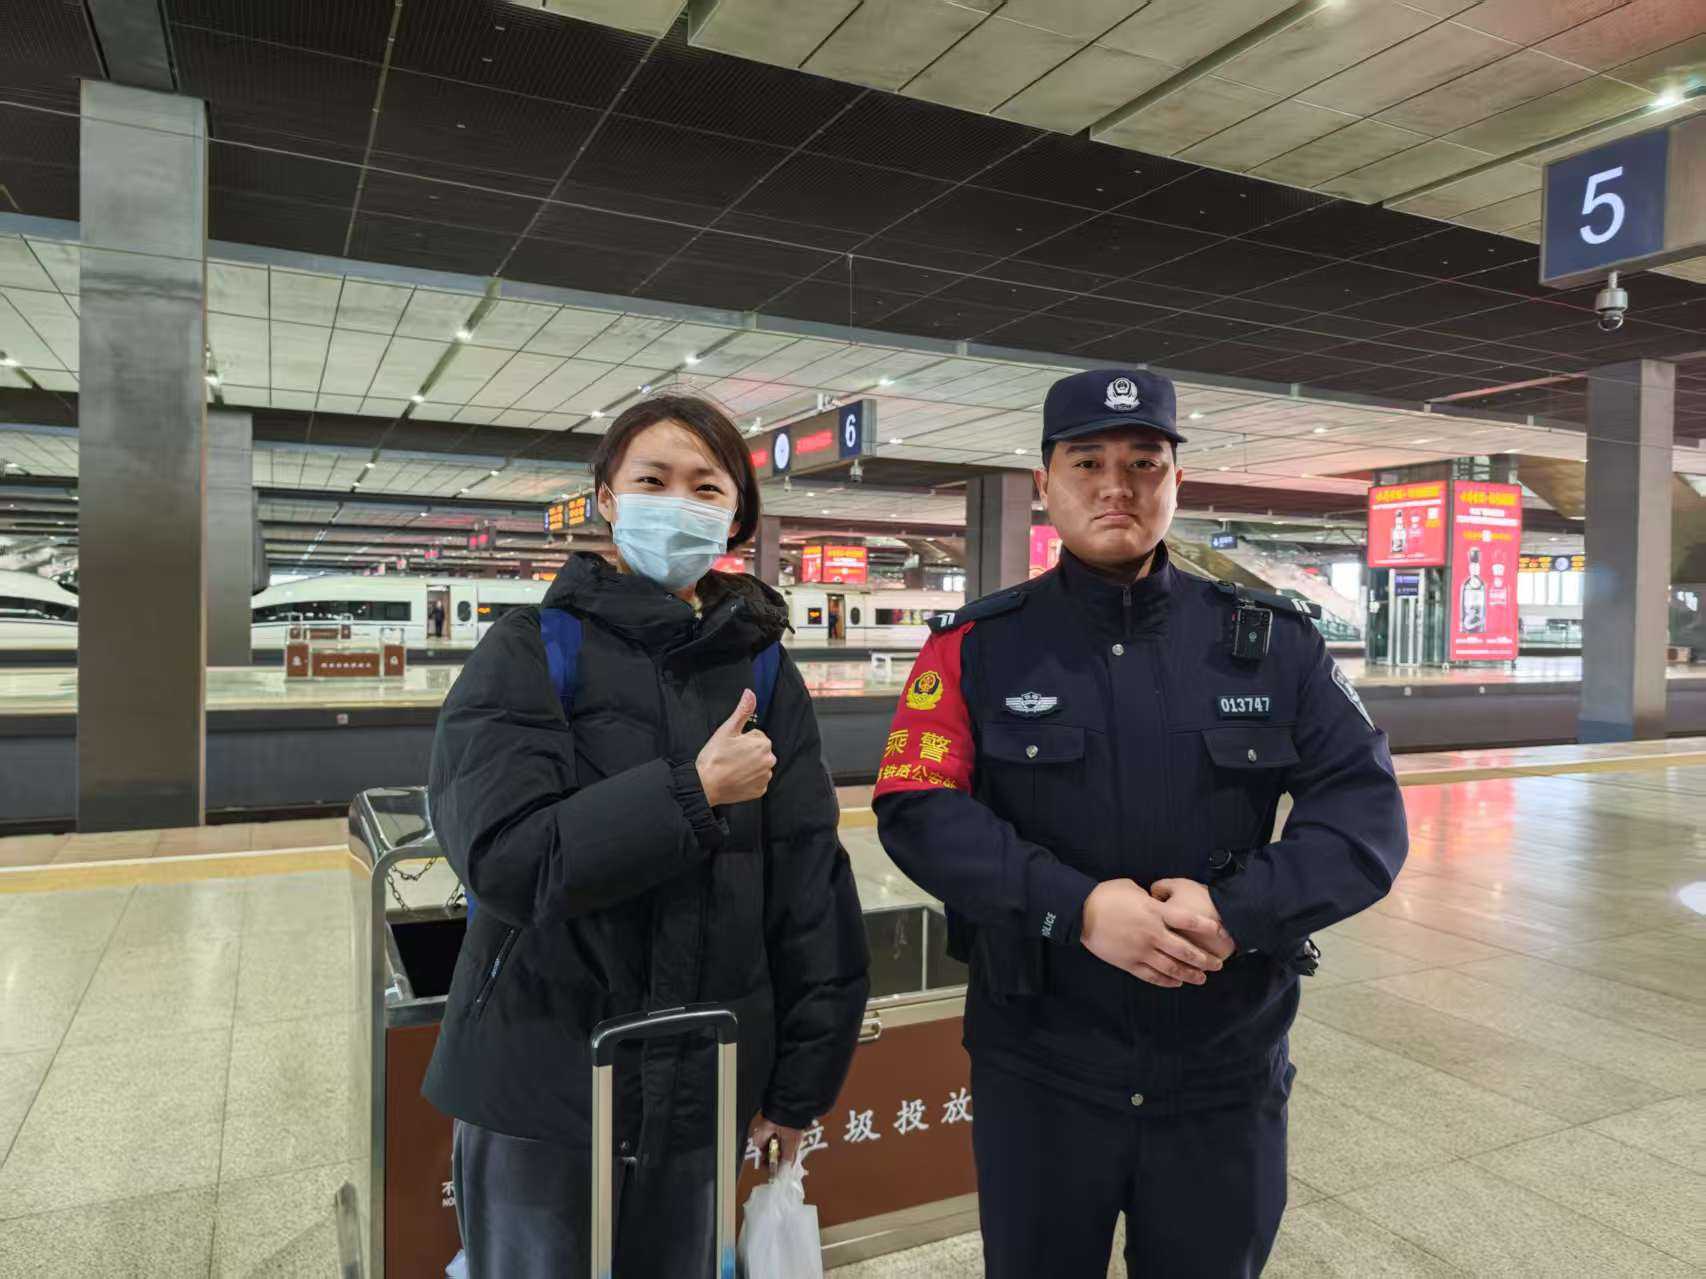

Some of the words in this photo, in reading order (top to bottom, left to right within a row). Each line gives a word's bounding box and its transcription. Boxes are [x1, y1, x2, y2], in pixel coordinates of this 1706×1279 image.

[1579, 166, 1626, 245] 5
[845, 413, 857, 448] 6
[1220, 696, 1271, 713] 013747
[884, 729, 952, 764] 乘警
